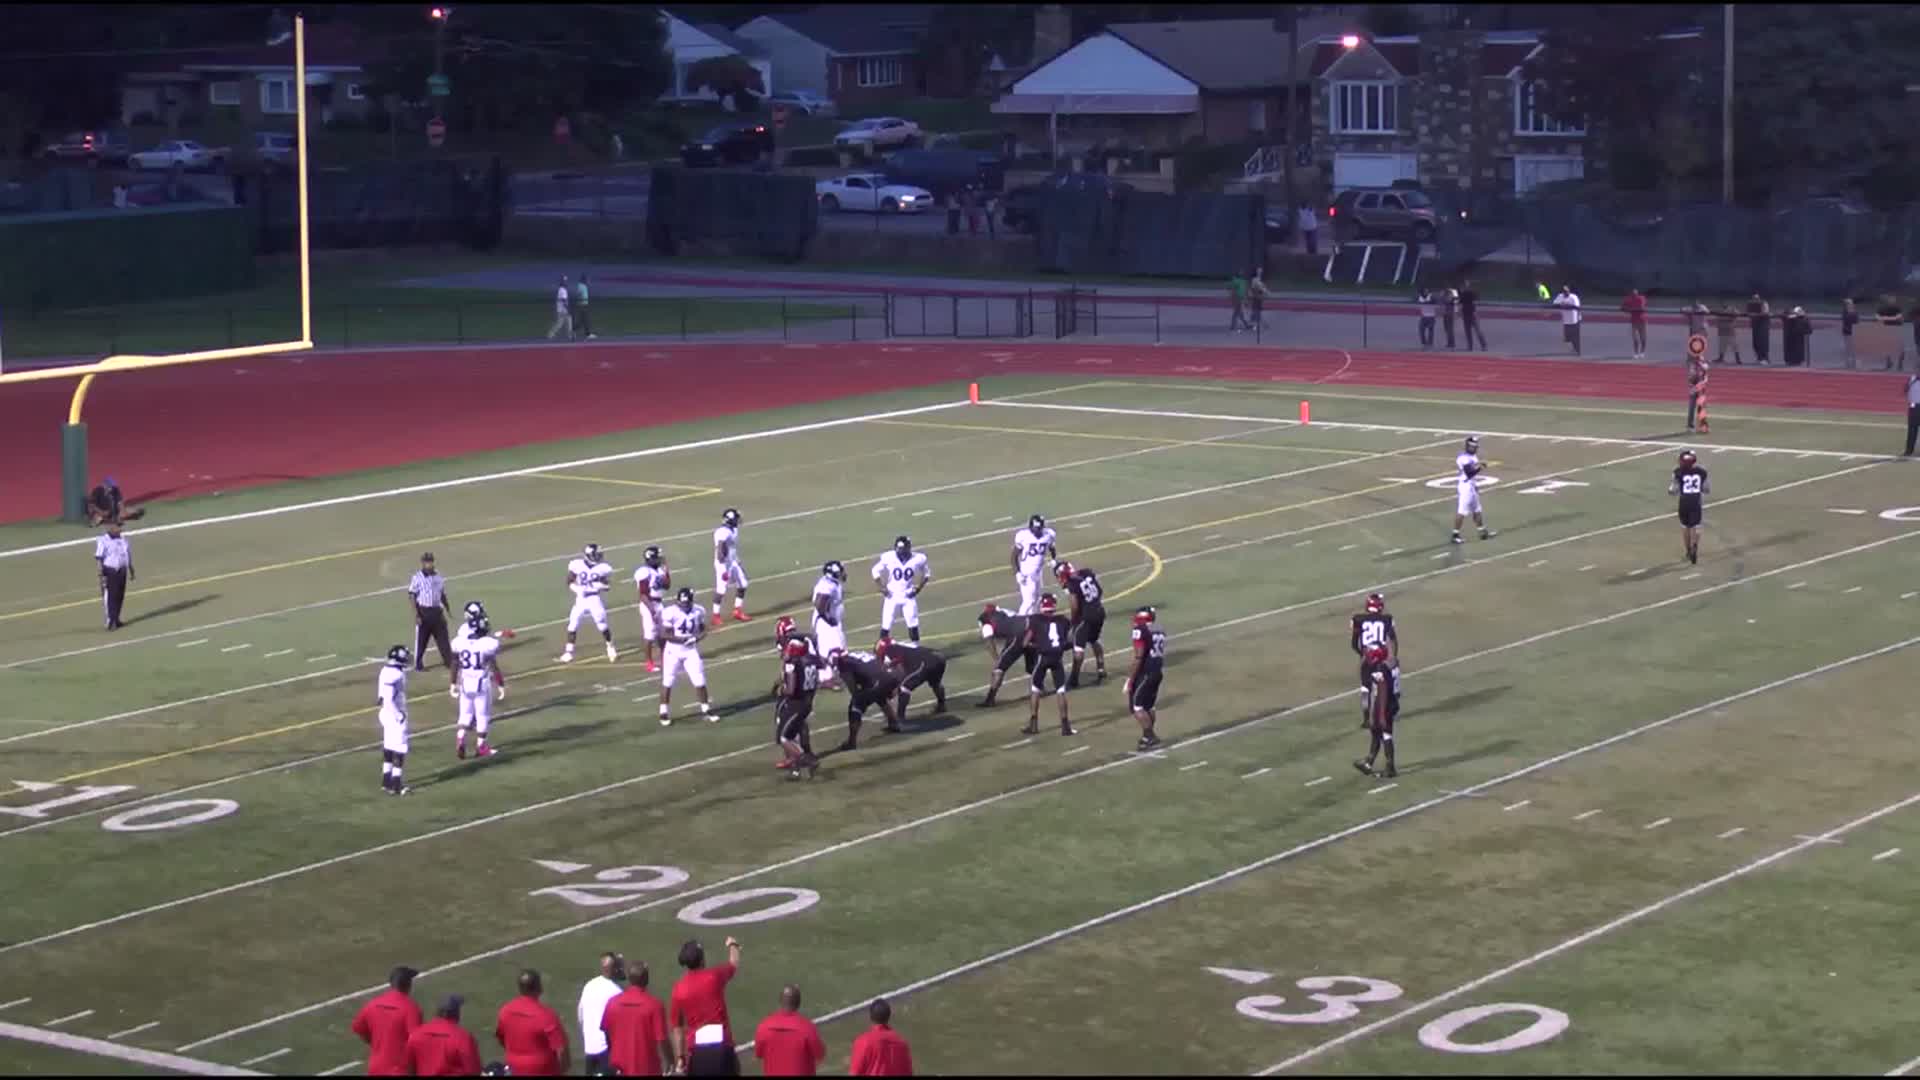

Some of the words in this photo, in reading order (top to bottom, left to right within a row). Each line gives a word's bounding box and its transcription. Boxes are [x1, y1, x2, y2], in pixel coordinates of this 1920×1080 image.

[1681, 474, 1702, 494] 23
[1048, 621, 1060, 648] 4
[1362, 620, 1385, 646] 20
[460, 649, 482, 670] 31
